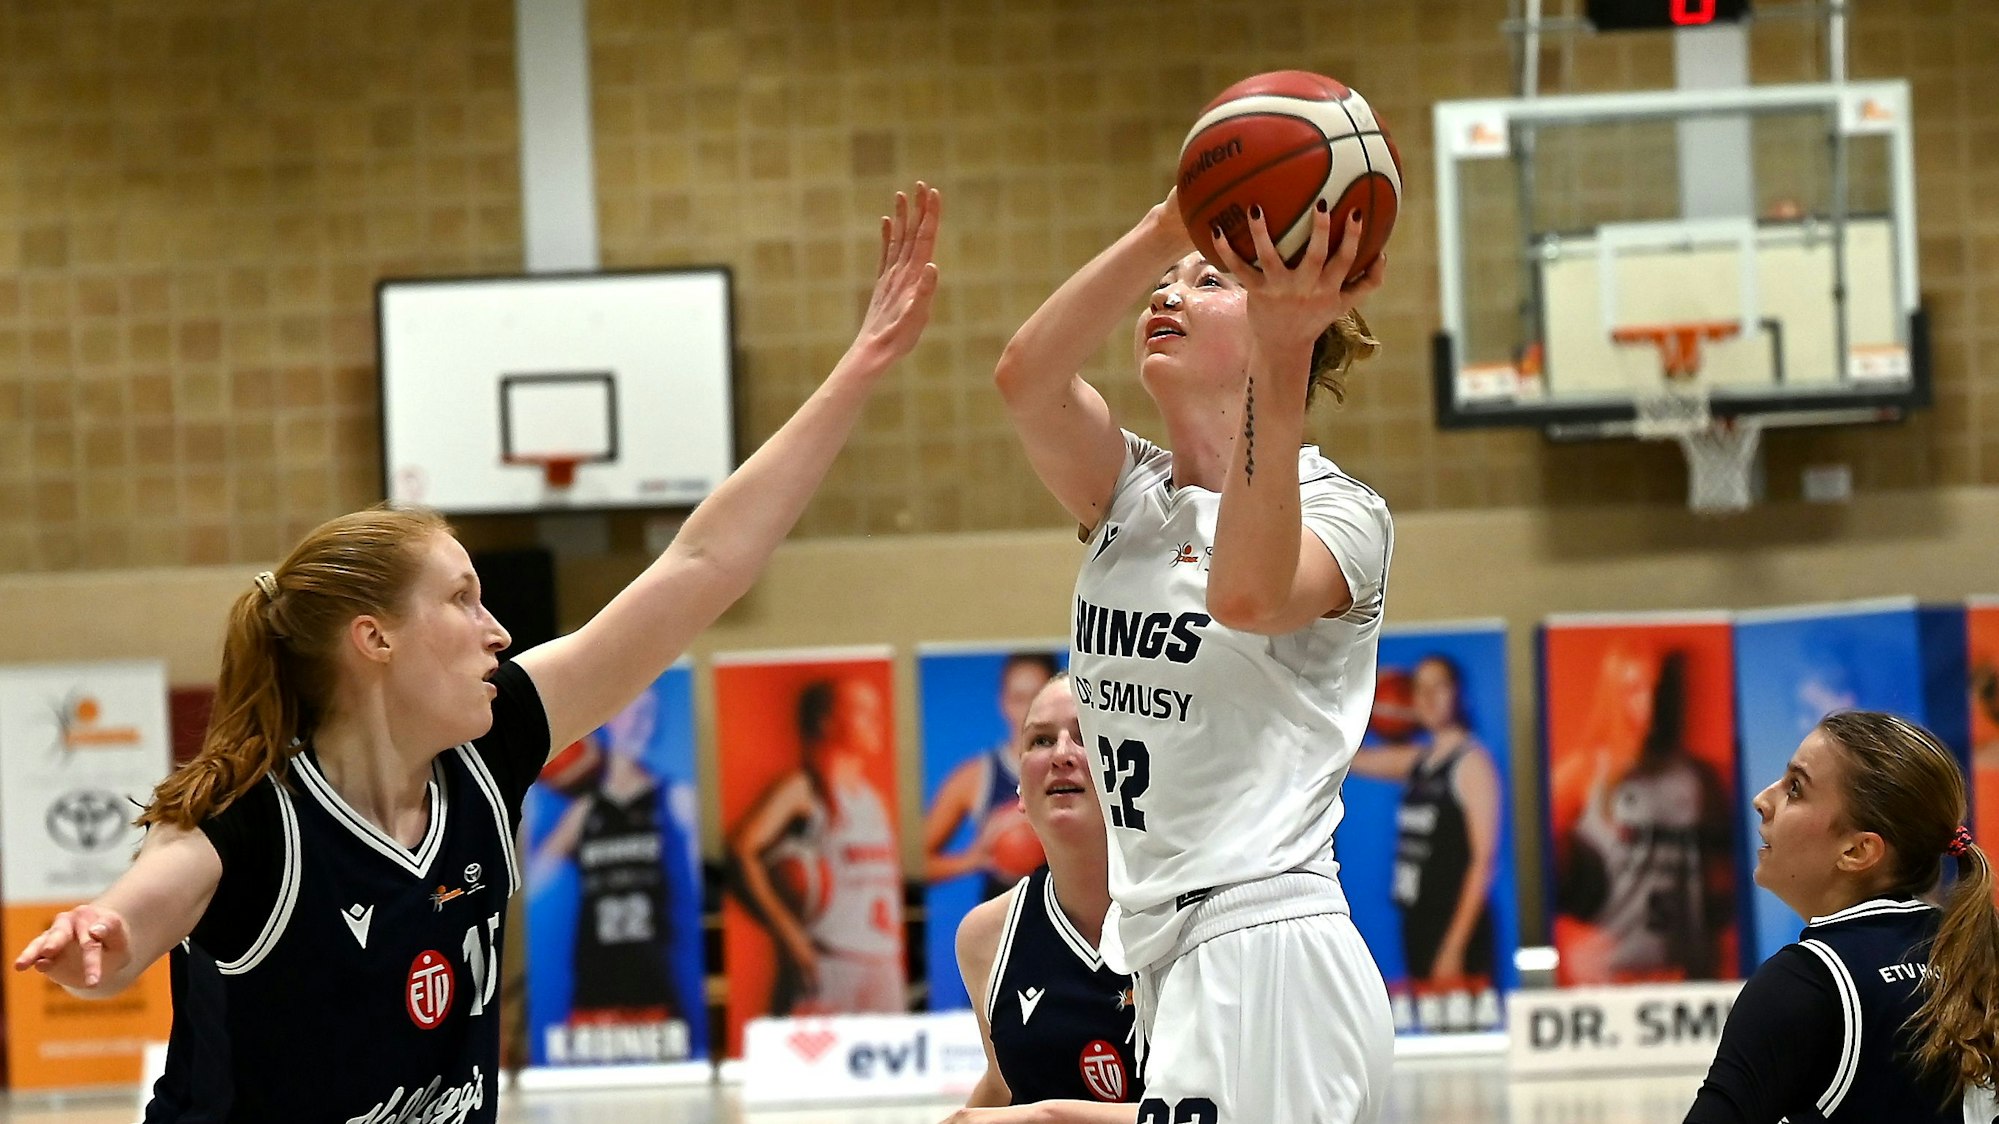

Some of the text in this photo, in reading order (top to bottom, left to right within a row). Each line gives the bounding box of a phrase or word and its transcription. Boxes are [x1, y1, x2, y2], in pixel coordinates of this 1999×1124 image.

[1076, 594, 1211, 664] WINGS
[1099, 680, 1193, 722] SMUSY
[1098, 734, 1150, 833] 22
[411, 961, 449, 1024] ETV
[1879, 962, 1916, 984] ETV
[1529, 1000, 1733, 1049] DR. SM
[847, 1029, 927, 1079] evl
[1084, 1053, 1122, 1099] ETV
